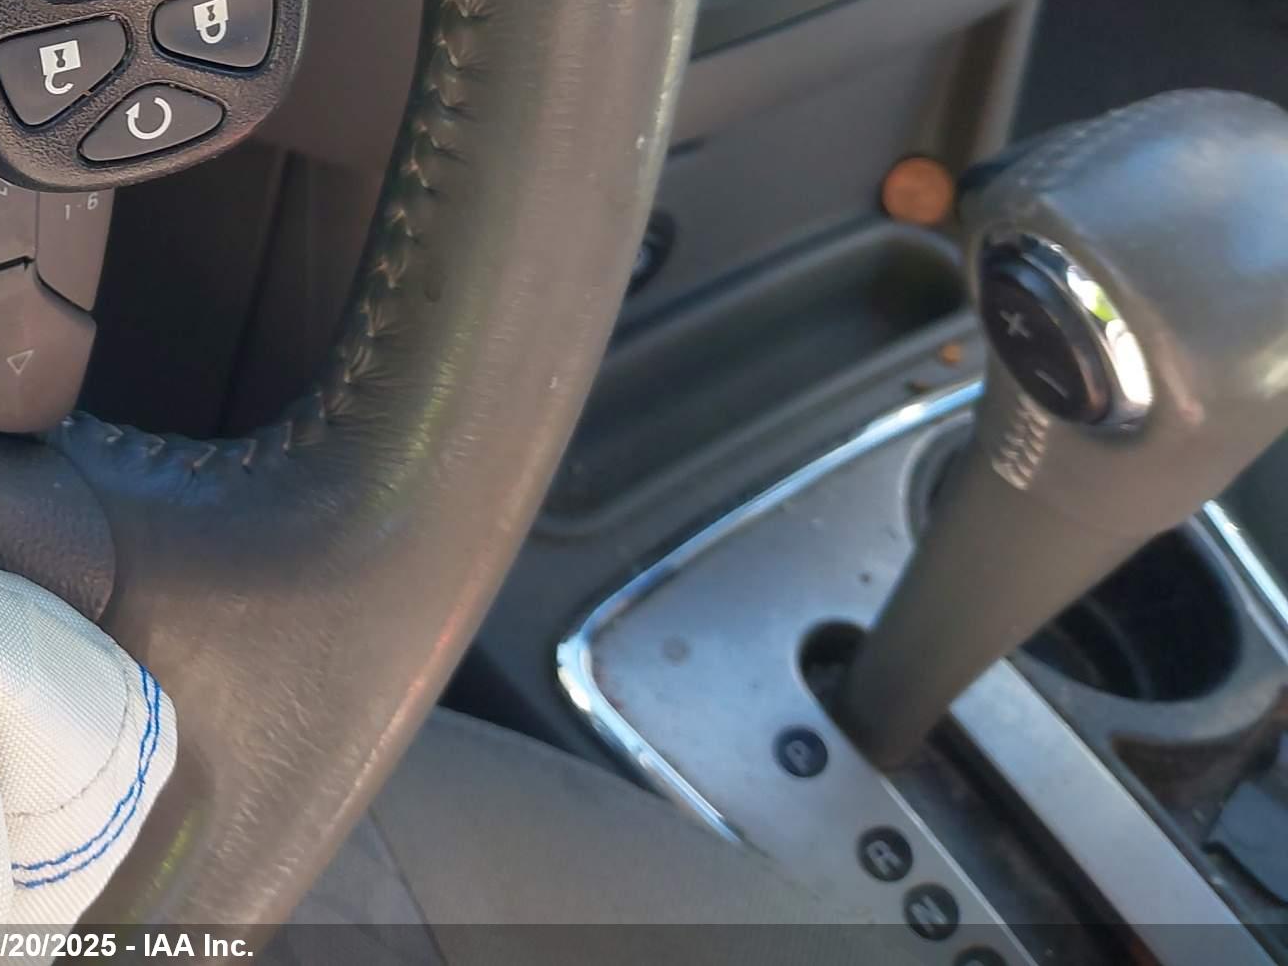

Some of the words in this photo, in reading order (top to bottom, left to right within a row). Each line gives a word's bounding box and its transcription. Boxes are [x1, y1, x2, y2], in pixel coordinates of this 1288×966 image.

[785, 739, 809, 771] P
[866, 839, 903, 876] R
[912, 895, 948, 933] N
